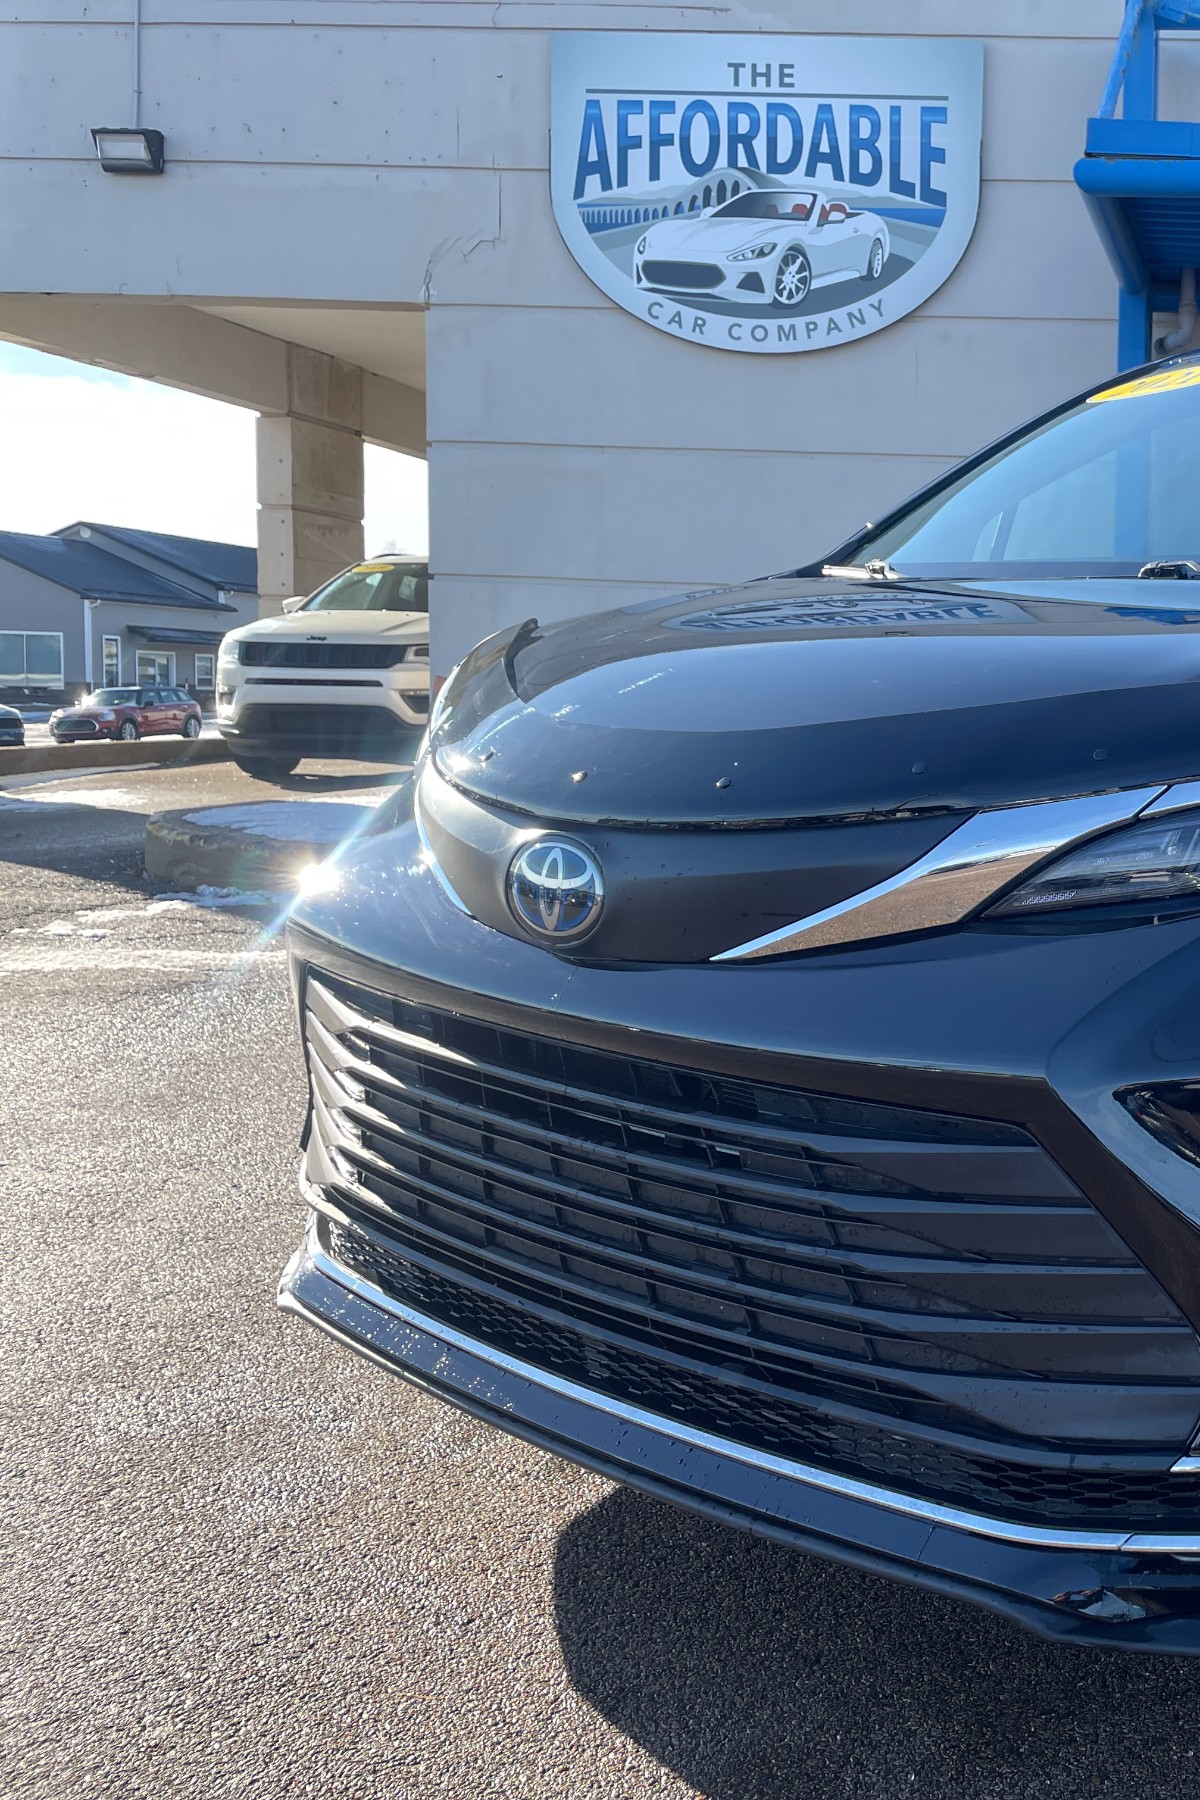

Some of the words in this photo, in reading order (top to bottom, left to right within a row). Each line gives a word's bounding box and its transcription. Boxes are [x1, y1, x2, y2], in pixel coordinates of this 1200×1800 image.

[726, 62, 796, 89] THE
[572, 98, 949, 208] AFFORDABLE
[646, 301, 708, 335] CAR
[727, 298, 885, 343] COMPANY
